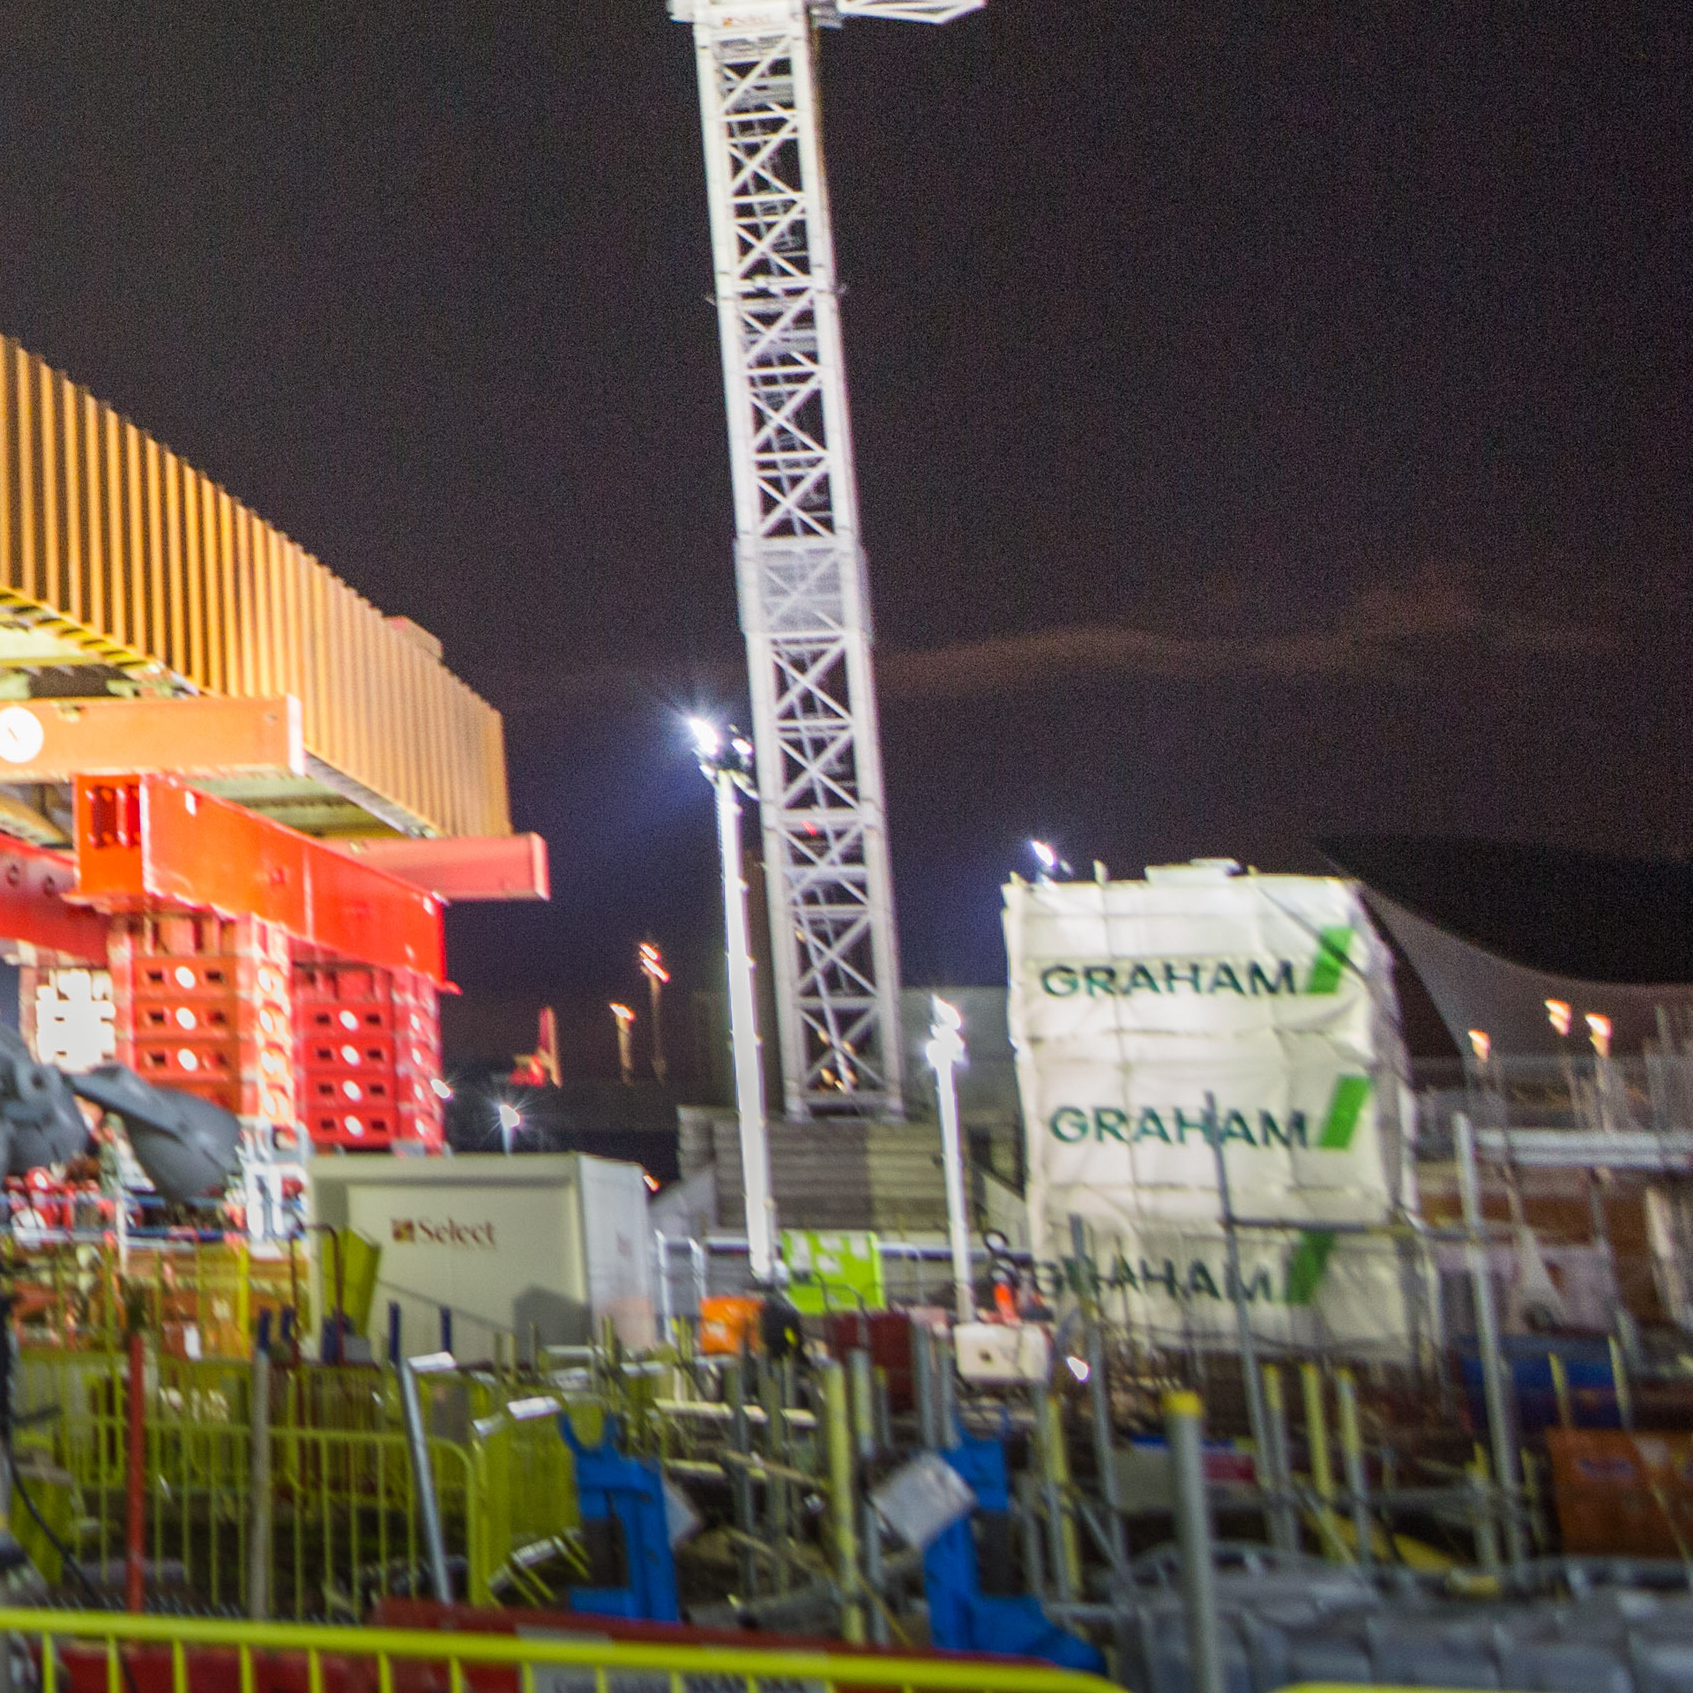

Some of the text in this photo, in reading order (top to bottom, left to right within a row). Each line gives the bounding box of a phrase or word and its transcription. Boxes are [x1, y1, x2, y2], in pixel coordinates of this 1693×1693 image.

[1040, 960, 1297, 997] GRAHAM
[1050, 1107, 1309, 1149] GRAHAM
[417, 1218, 496, 1249] Select
